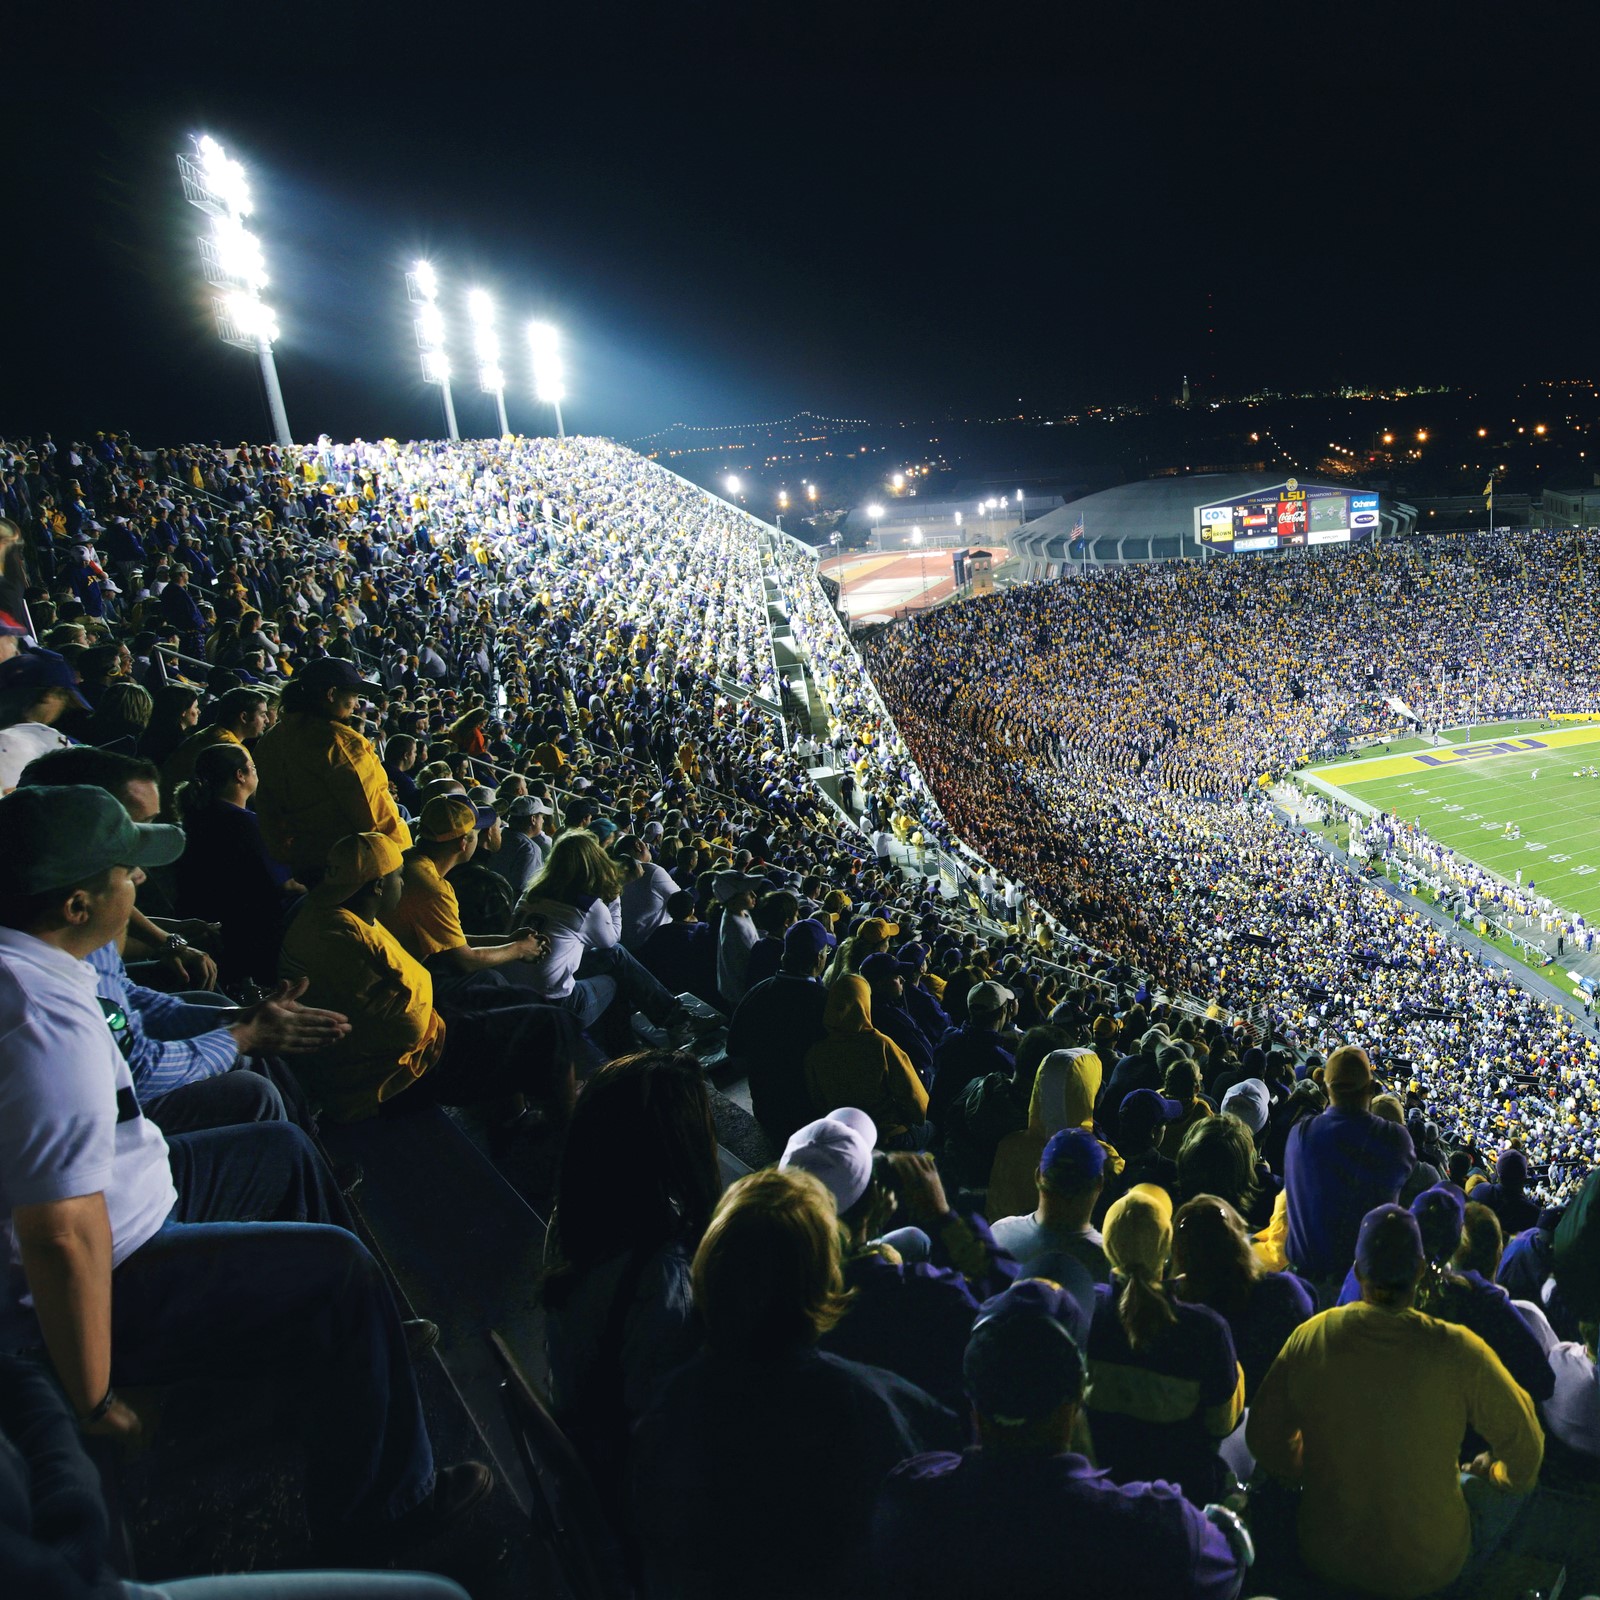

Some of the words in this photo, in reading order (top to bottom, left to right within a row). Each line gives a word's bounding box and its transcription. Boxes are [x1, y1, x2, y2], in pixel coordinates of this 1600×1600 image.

[1280, 490, 1305, 501] LSU
[1204, 510, 1226, 520] COX
[1412, 738, 1548, 767] LSU
[1547, 853, 1572, 863] 45
[1570, 864, 1597, 876] 50
